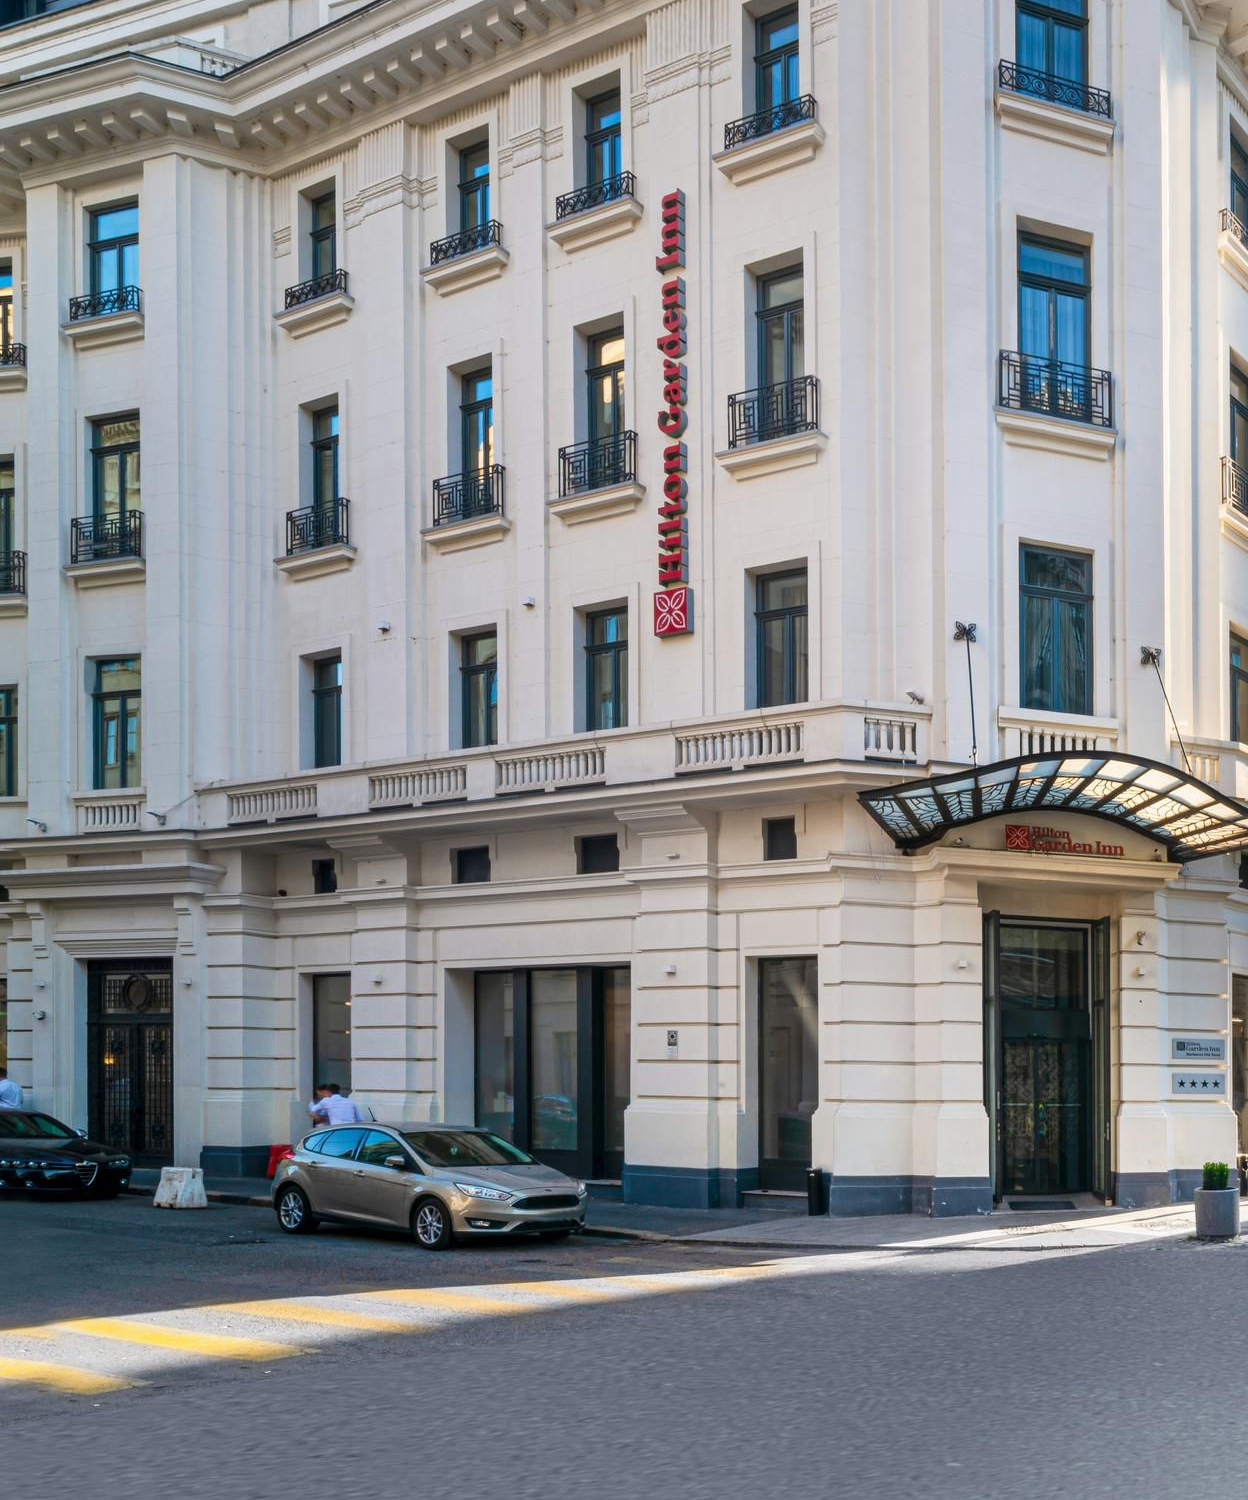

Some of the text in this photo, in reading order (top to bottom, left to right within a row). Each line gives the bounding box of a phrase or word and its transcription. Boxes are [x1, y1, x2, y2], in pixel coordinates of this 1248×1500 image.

[656, 188, 688, 587] Hilton Garden Inn
[1032, 826, 1070, 839] Hilton
[1032, 835, 1125, 856] Garden Inn
